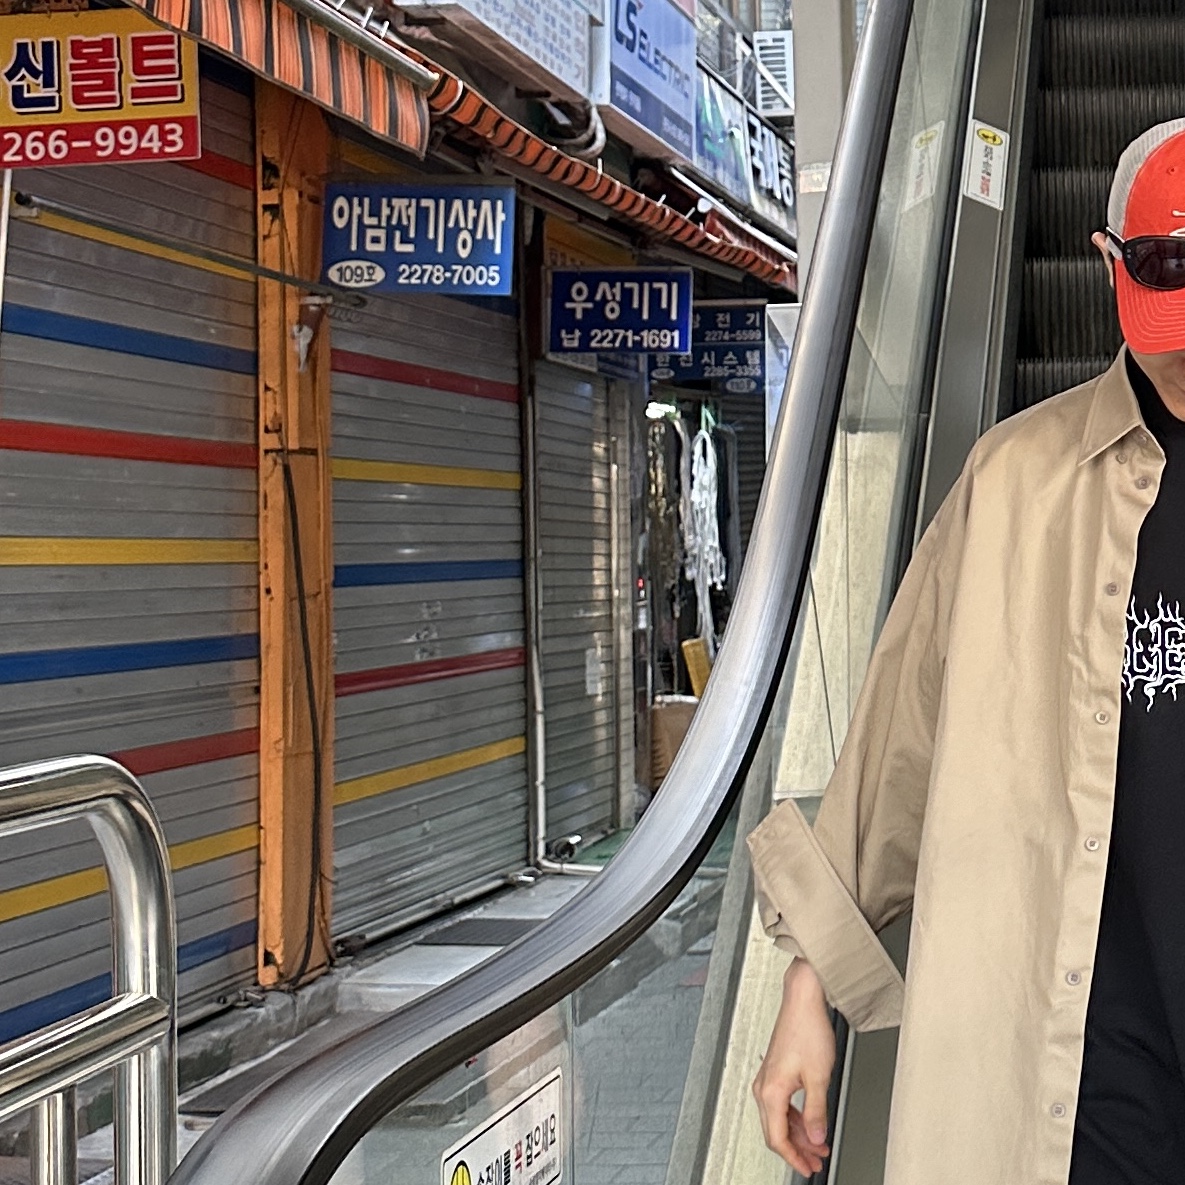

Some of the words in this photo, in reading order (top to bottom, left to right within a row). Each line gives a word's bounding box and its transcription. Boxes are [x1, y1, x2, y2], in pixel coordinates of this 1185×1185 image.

[4, 33, 183, 114] 신볼트
[3, 123, 184, 162] 266-9943
[332, 195, 506, 259] 아남전기상사
[336, 265, 377, 284] 109호
[398, 263, 501, 286] 2278-7005
[564, 281, 678, 321] 우성기기
[590, 328, 680, 348] 2271-1691
[514, 1139, 523, 1174] 꼭
[525, 1113, 556, 1168] 잡으세요
